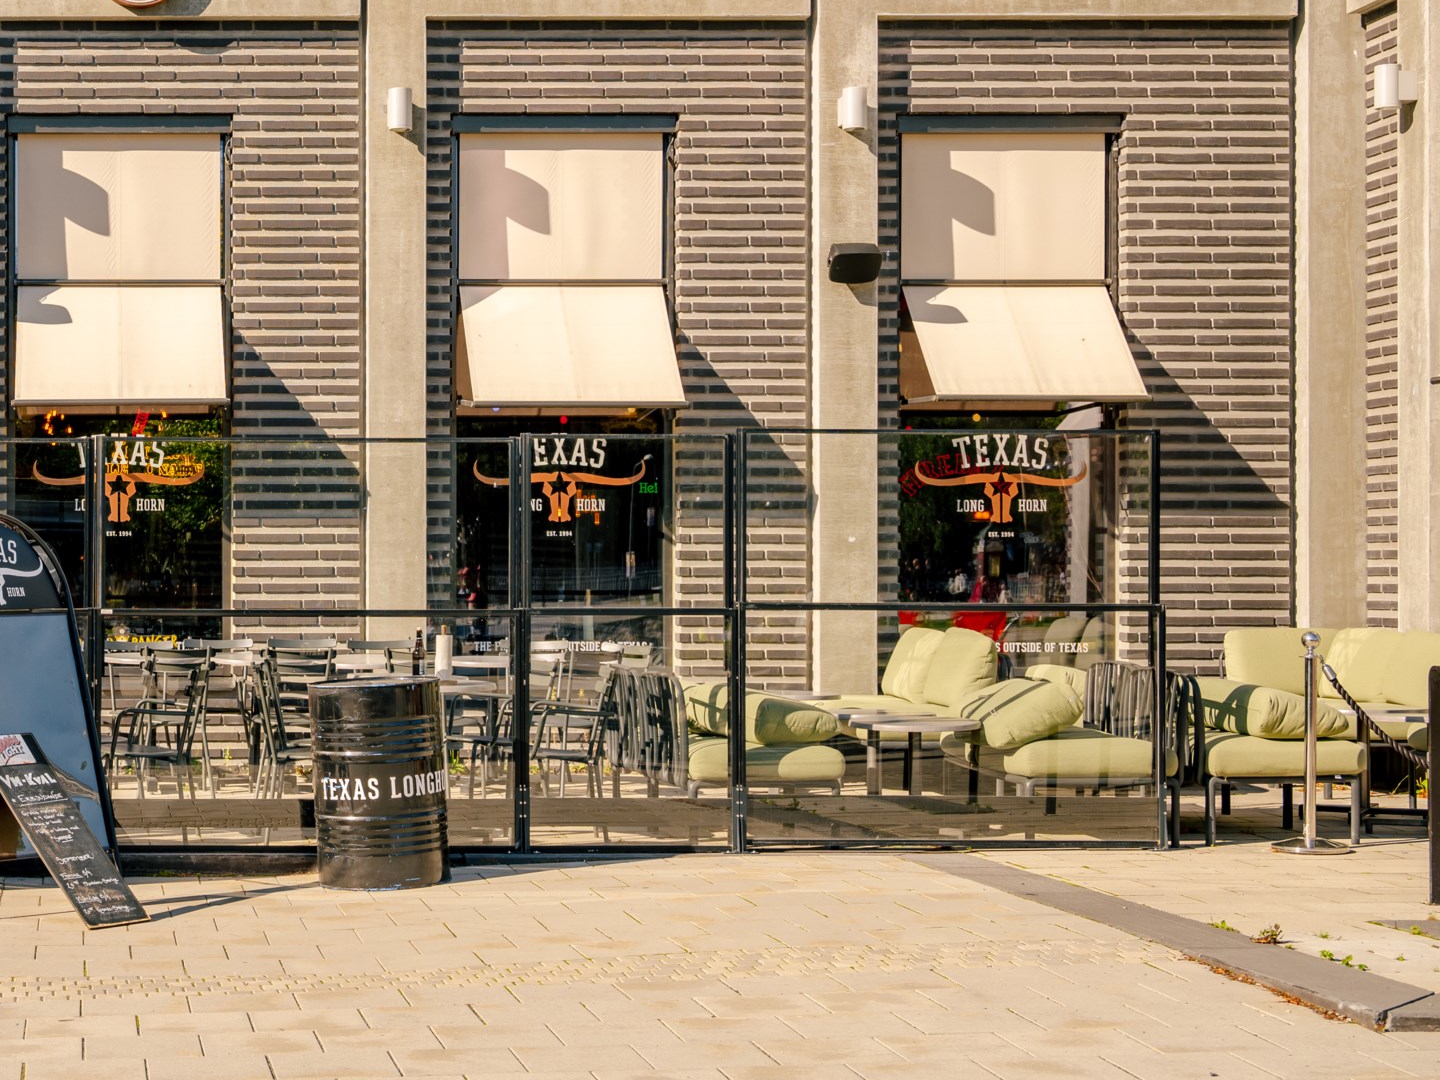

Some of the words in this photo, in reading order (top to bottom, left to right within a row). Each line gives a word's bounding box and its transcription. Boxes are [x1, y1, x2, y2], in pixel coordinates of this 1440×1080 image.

[532, 433, 608, 469] EXAS
[951, 433, 1049, 470] TEXAS
[638, 481, 659, 494] Hei
[136, 498, 165, 512] HORN
[576, 498, 606, 512] HORN
[956, 499, 985, 512] LONG
[1018, 499, 1048, 512] HORN
[6, 587, 26, 597] HORN
[474, 641, 492, 652] THE
[1003, 642, 1042, 653] OUTSIDE
[1044, 642, 1056, 653] OF
[1059, 642, 1089, 653] TEXAS
[321, 777, 380, 800] TEXAS
